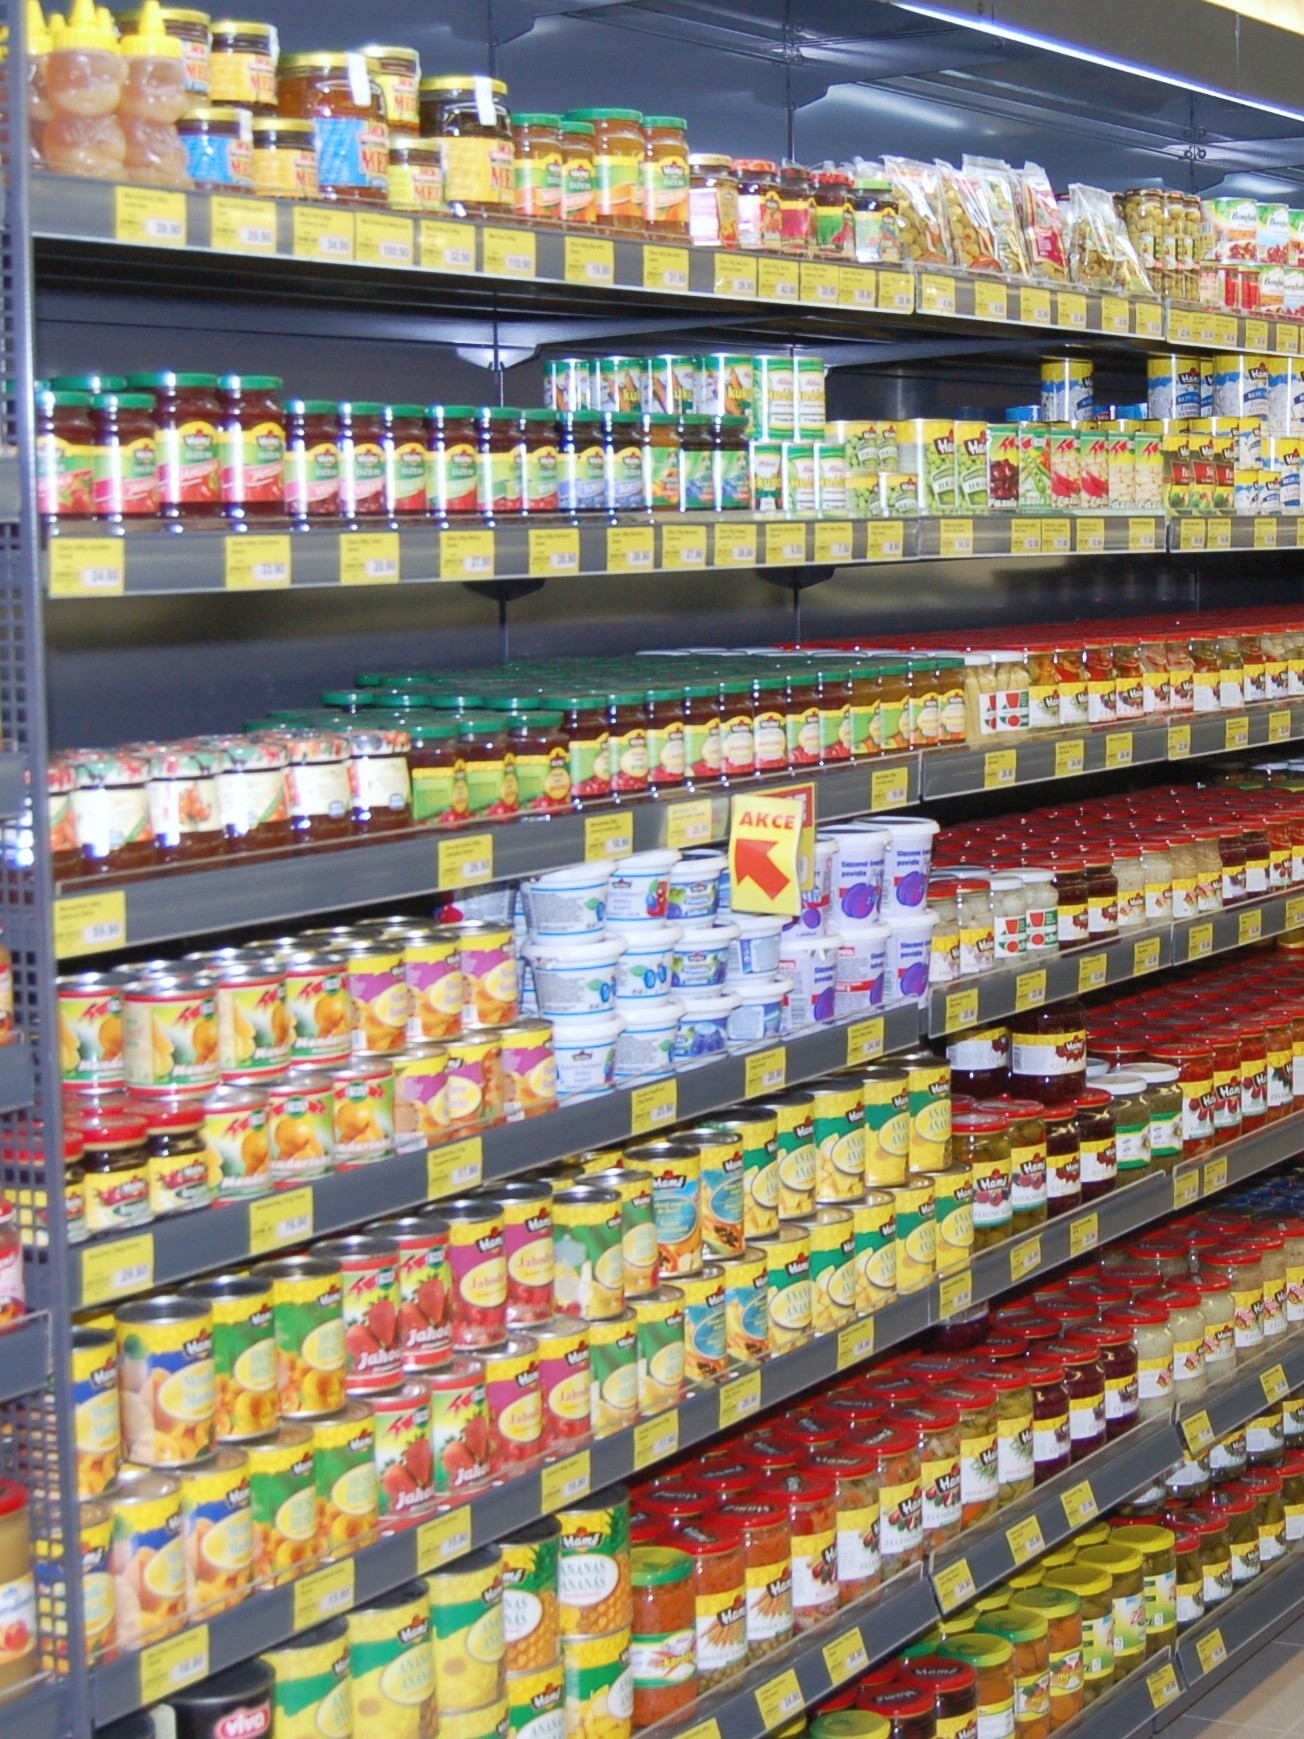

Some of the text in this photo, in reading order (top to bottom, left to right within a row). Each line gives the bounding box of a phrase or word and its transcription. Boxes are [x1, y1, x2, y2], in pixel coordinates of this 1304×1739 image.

[937, 439, 954, 454] Ha
[968, 442, 987, 455] Ha
[739, 811, 795, 831] AKCE
[1220, 1085, 1240, 1098] Ham
[981, 1175, 1008, 1191] Hamé
[939, 1476, 960, 1492] Ham
[902, 1499, 921, 1514] Ham
[562, 1535, 597, 1548] Hamé
[560, 1562, 606, 1576] ANANAS
[771, 1579, 792, 1597] Ham
[722, 1605, 746, 1625] Ham
